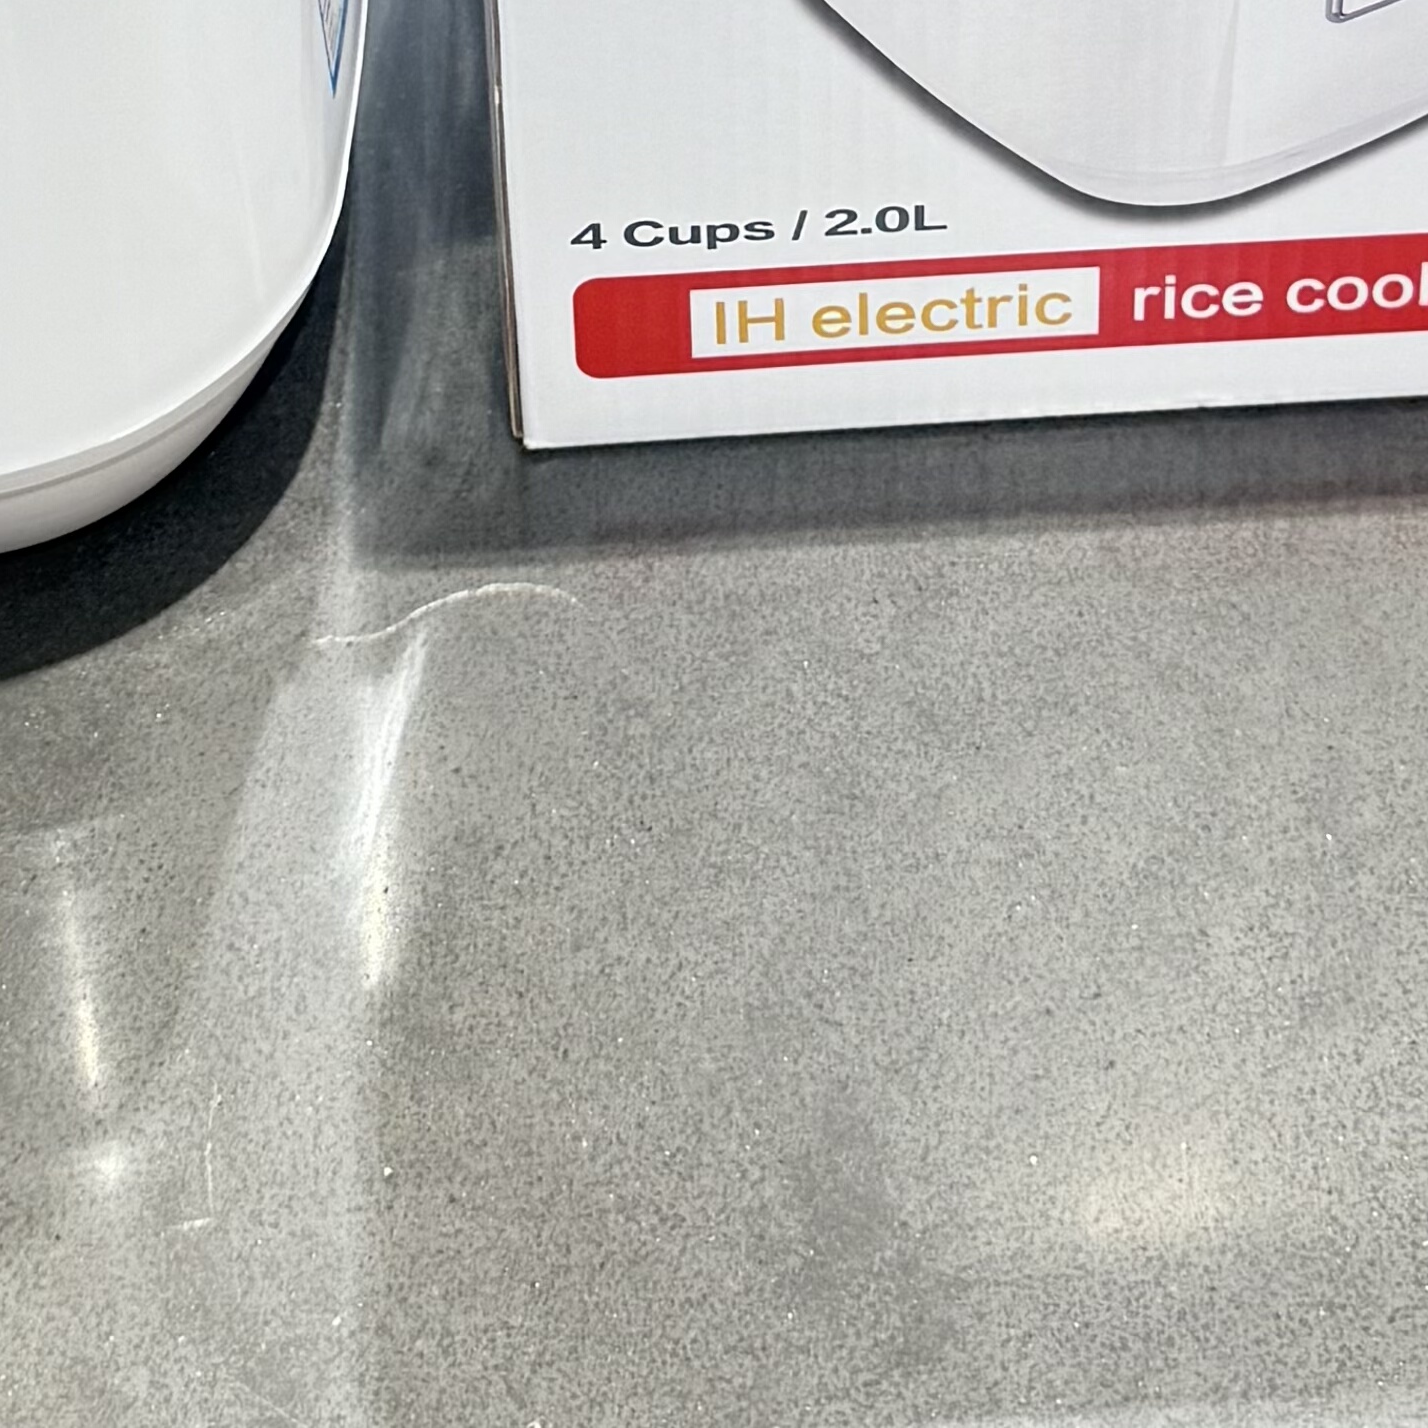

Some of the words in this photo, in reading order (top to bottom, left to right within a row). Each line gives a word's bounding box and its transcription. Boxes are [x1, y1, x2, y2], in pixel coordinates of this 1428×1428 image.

[569, 220, 609, 250] 4
[623, 216, 776, 252] Cups
[790, 210, 809, 243] /
[823, 204, 949, 237] 2.0L
[713, 298, 786, 344] IH
[811, 283, 1074, 338] electric
[1130, 274, 1264, 322] rice
